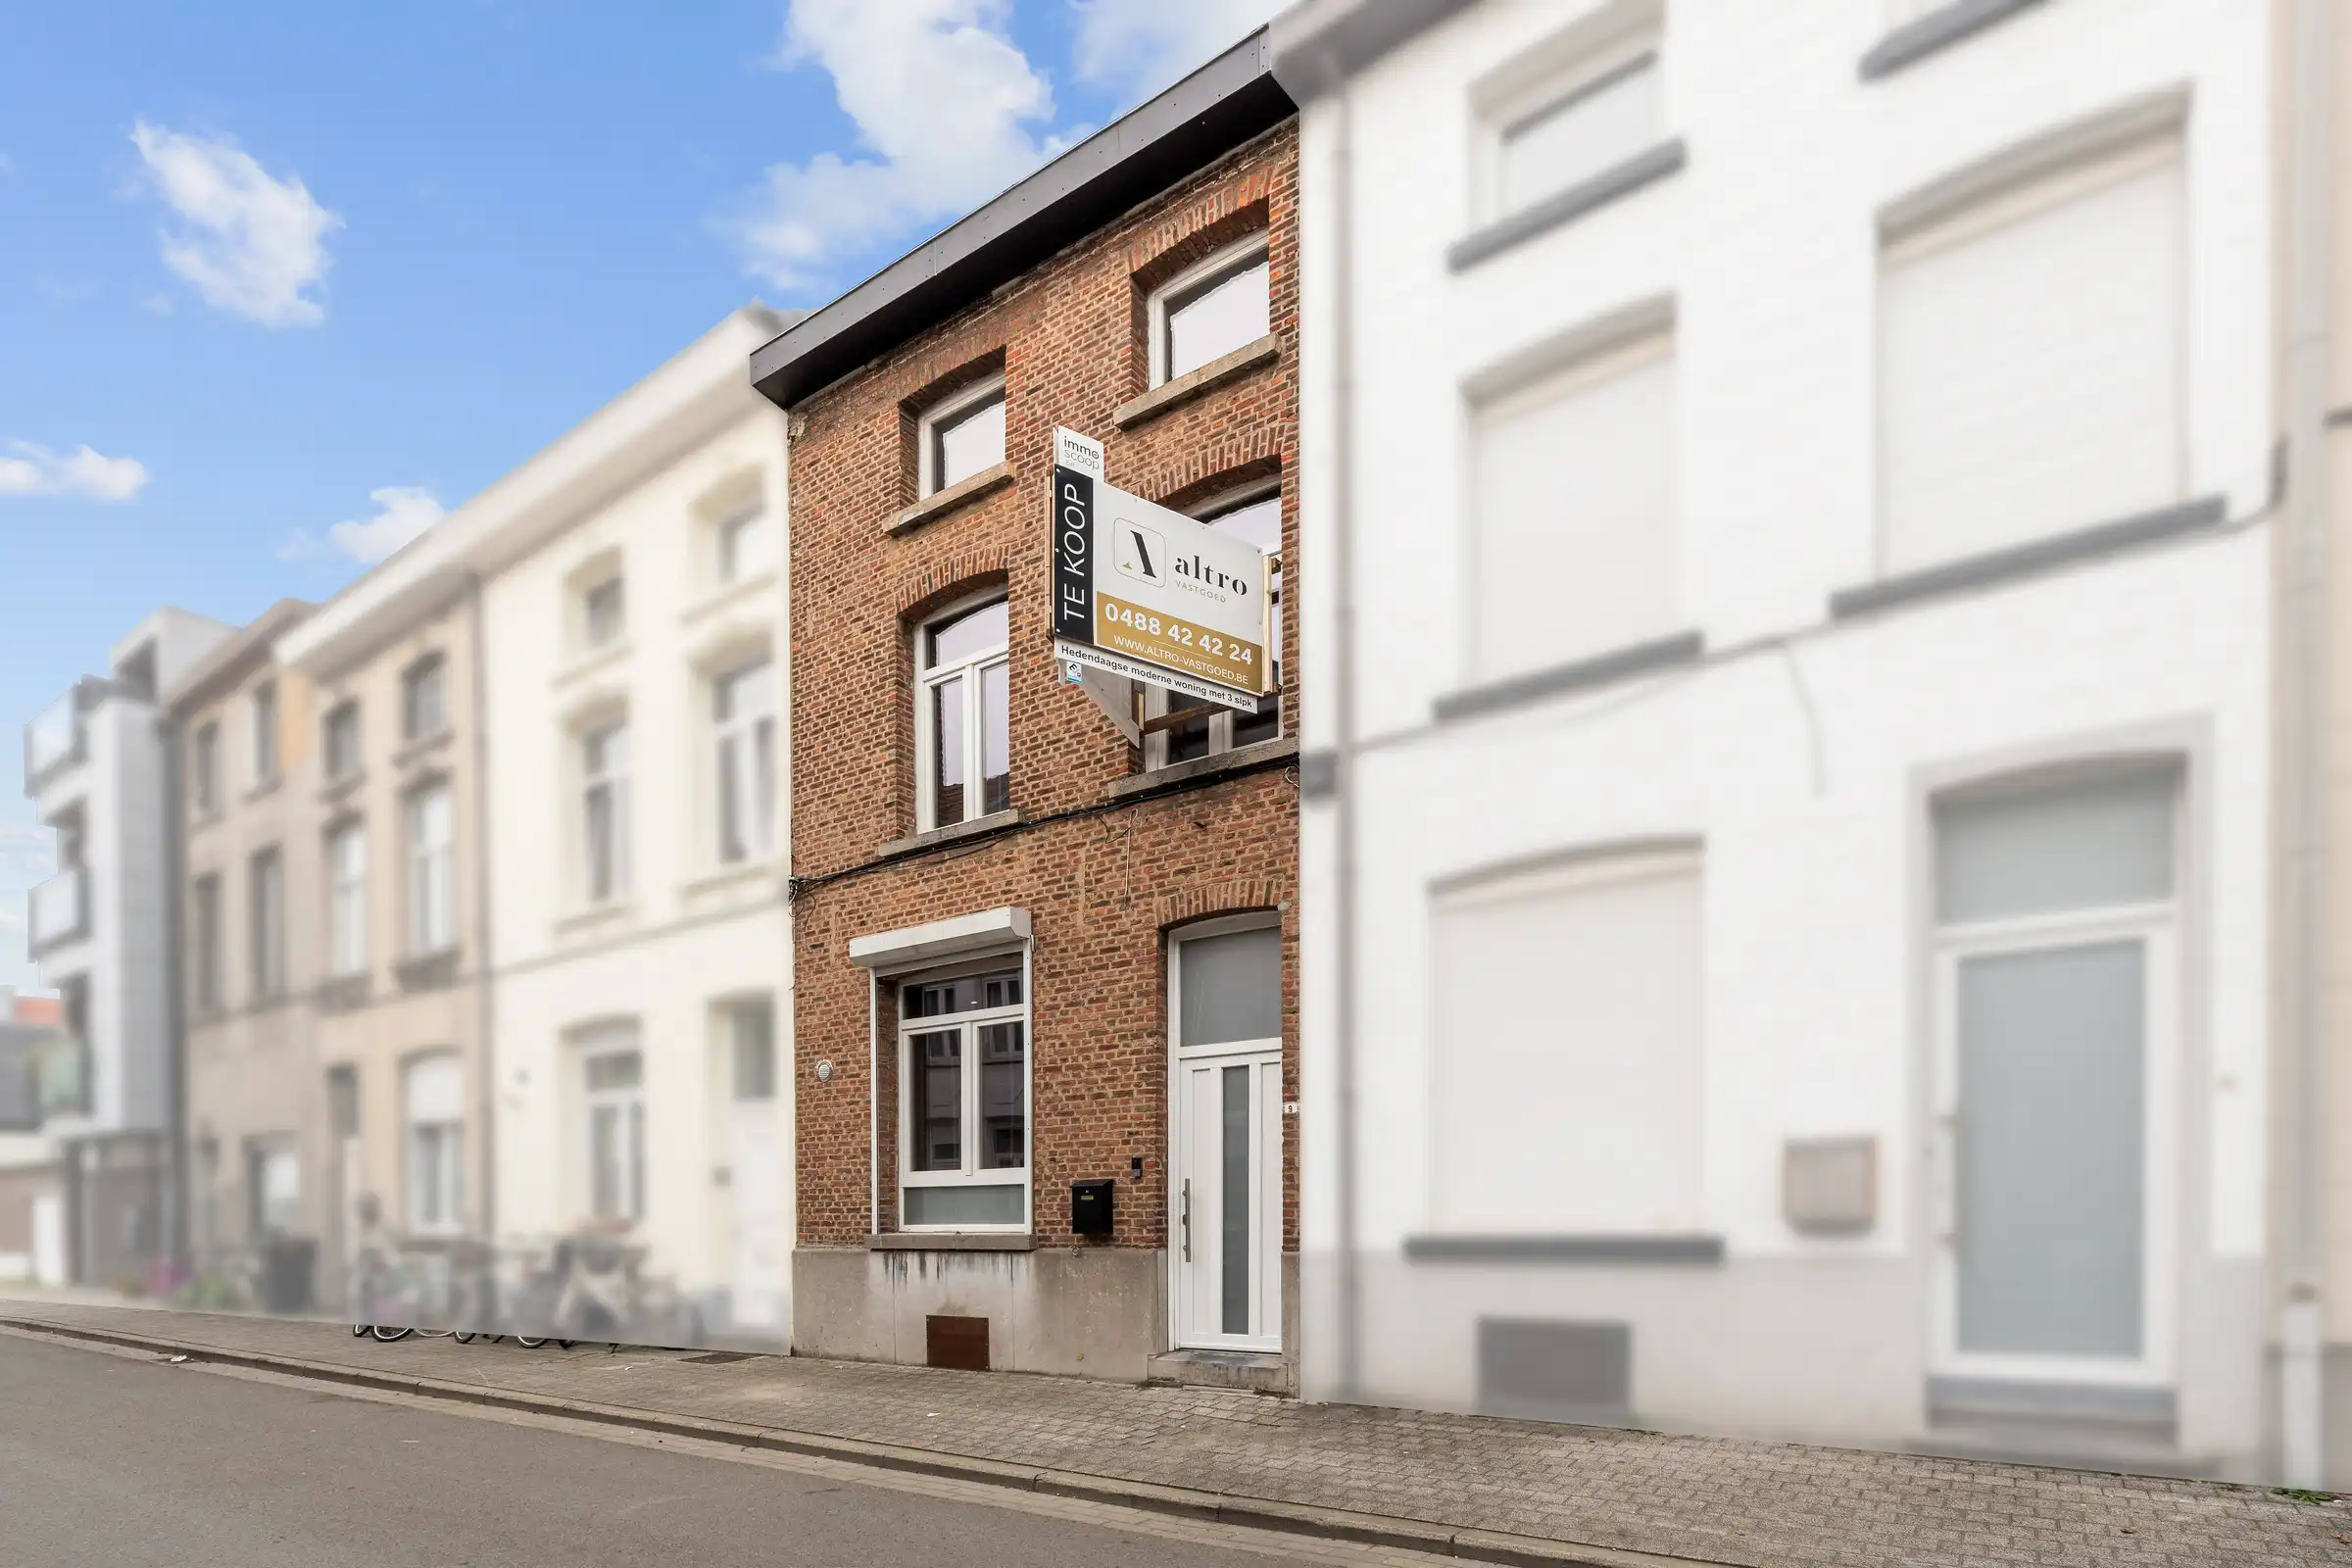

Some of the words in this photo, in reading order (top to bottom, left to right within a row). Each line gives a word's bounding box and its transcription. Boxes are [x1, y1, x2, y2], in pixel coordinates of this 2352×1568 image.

[1063, 435, 1100, 460] immo
[1064, 449, 1100, 470] scoop
[1063, 483, 1086, 577] KOOP
[1174, 554, 1248, 596] altro
[1175, 579, 1227, 604] VASTGOED
[1063, 583, 1085, 620] TE
[1104, 603, 1161, 636] 0488
[1167, 624, 1194, 647] 42
[1199, 634, 1224, 657] 42
[1229, 643, 1253, 665] 24
[1061, 645, 1129, 672] Hedendaagse
[1131, 666, 1173, 686] moderne
[1174, 678, 1207, 697] woning
[1208, 689, 1226, 701] met
[1227, 693, 1234, 703] 3
[1234, 697, 1252, 709] slpk
[1112, 634, 1250, 685] WWW.ALTRO-VASTGOED.BE
[1288, 1104, 1294, 1113] 9
